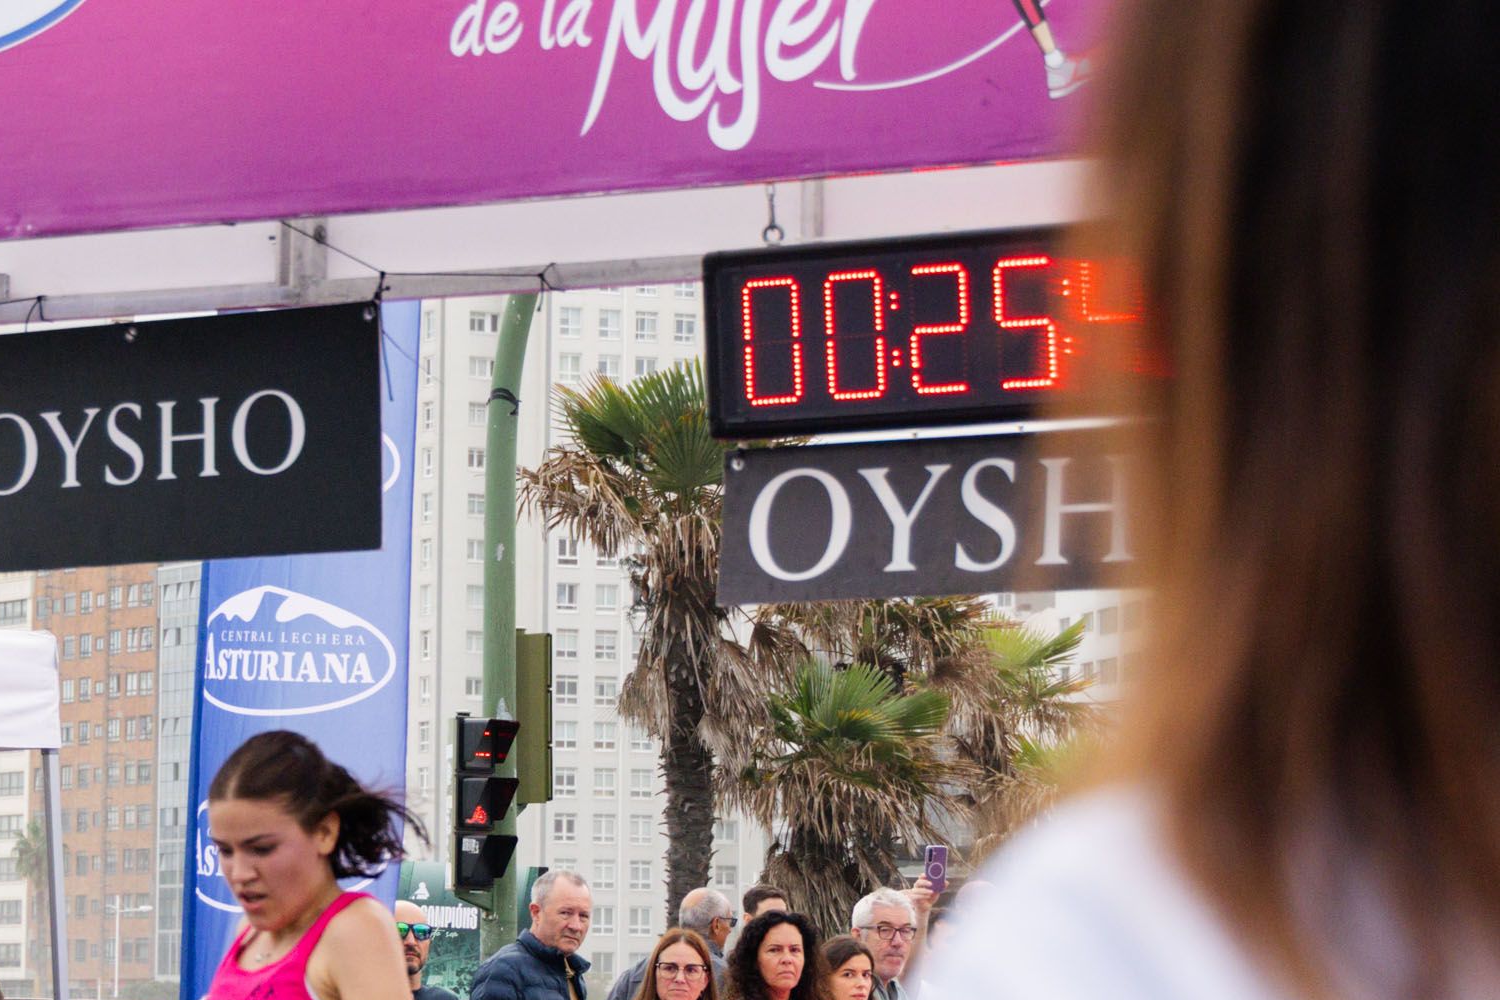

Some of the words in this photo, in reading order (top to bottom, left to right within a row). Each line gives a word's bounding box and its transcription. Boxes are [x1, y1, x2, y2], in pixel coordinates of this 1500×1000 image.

[579, 0, 877, 151] Mujer
[748, 456, 1135, 583] OYSH
[204, 631, 376, 685] ASTURIANA
[220, 629, 274, 643] CENTRAL
[279, 630, 366, 646] LECHERA
